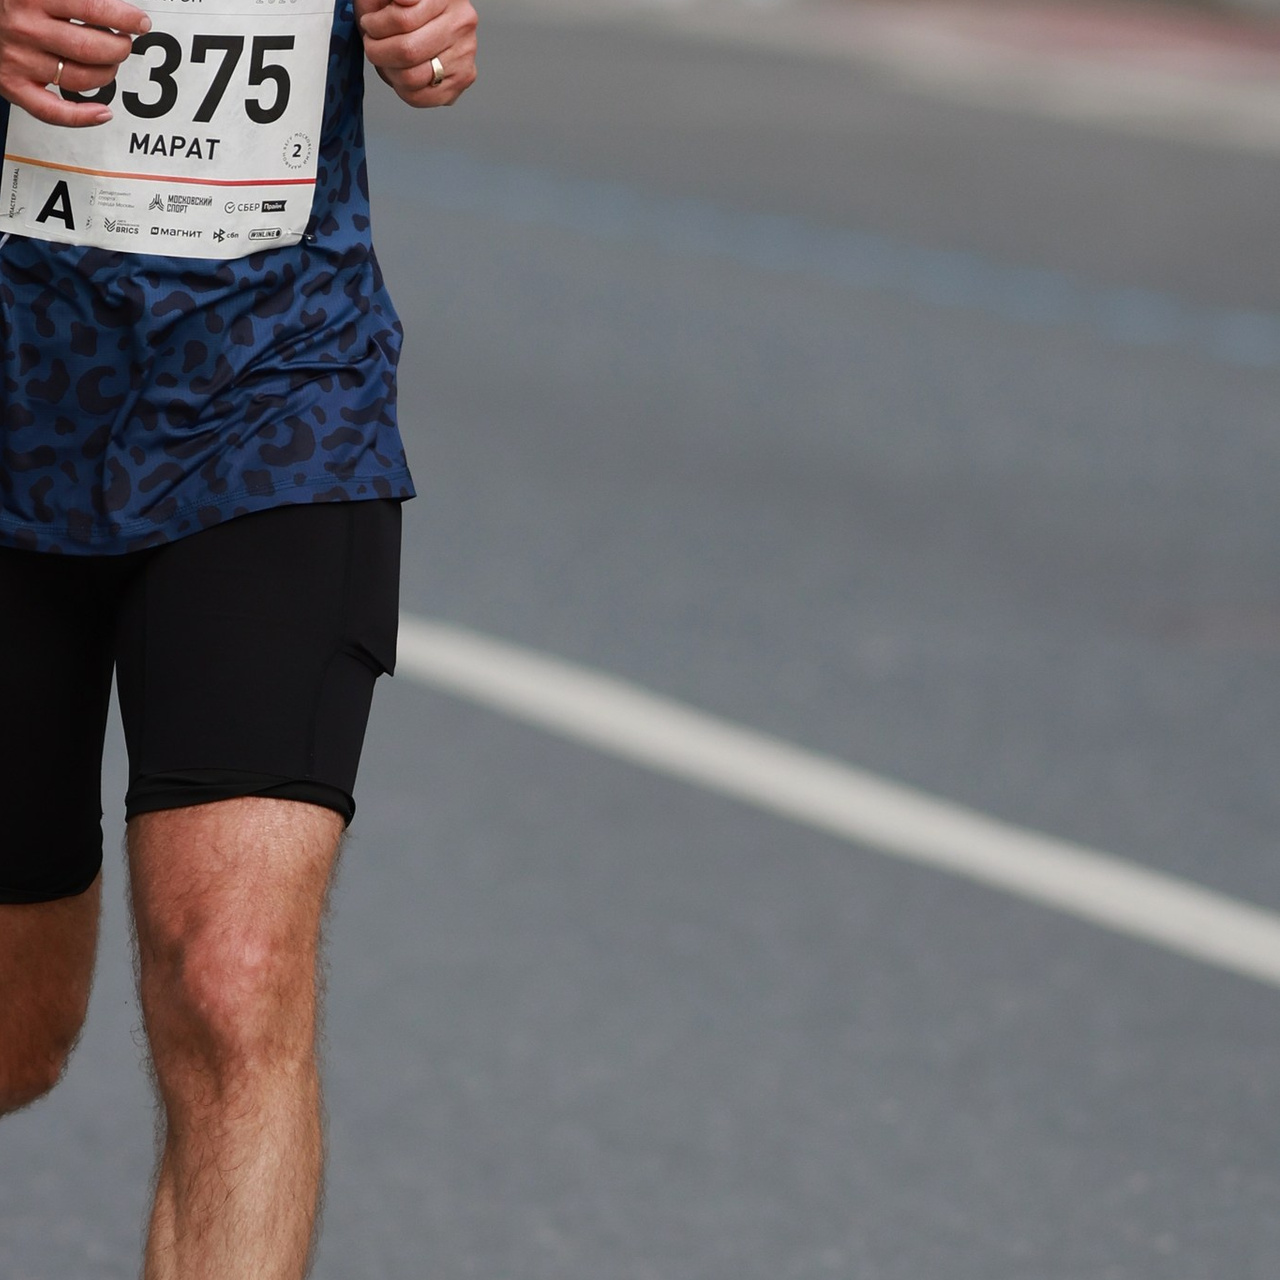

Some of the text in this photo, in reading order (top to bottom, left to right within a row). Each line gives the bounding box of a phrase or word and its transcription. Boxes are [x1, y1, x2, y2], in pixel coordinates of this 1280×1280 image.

[129, 132, 220, 160] МАРАТ
[292, 144, 302, 158] 2
[168, 195, 213, 206] МОСКОВСКИЙ
[166, 203, 189, 213] СПОРТ
[237, 203, 260, 212] СБЕР
[115, 226, 140, 235] BRICS
